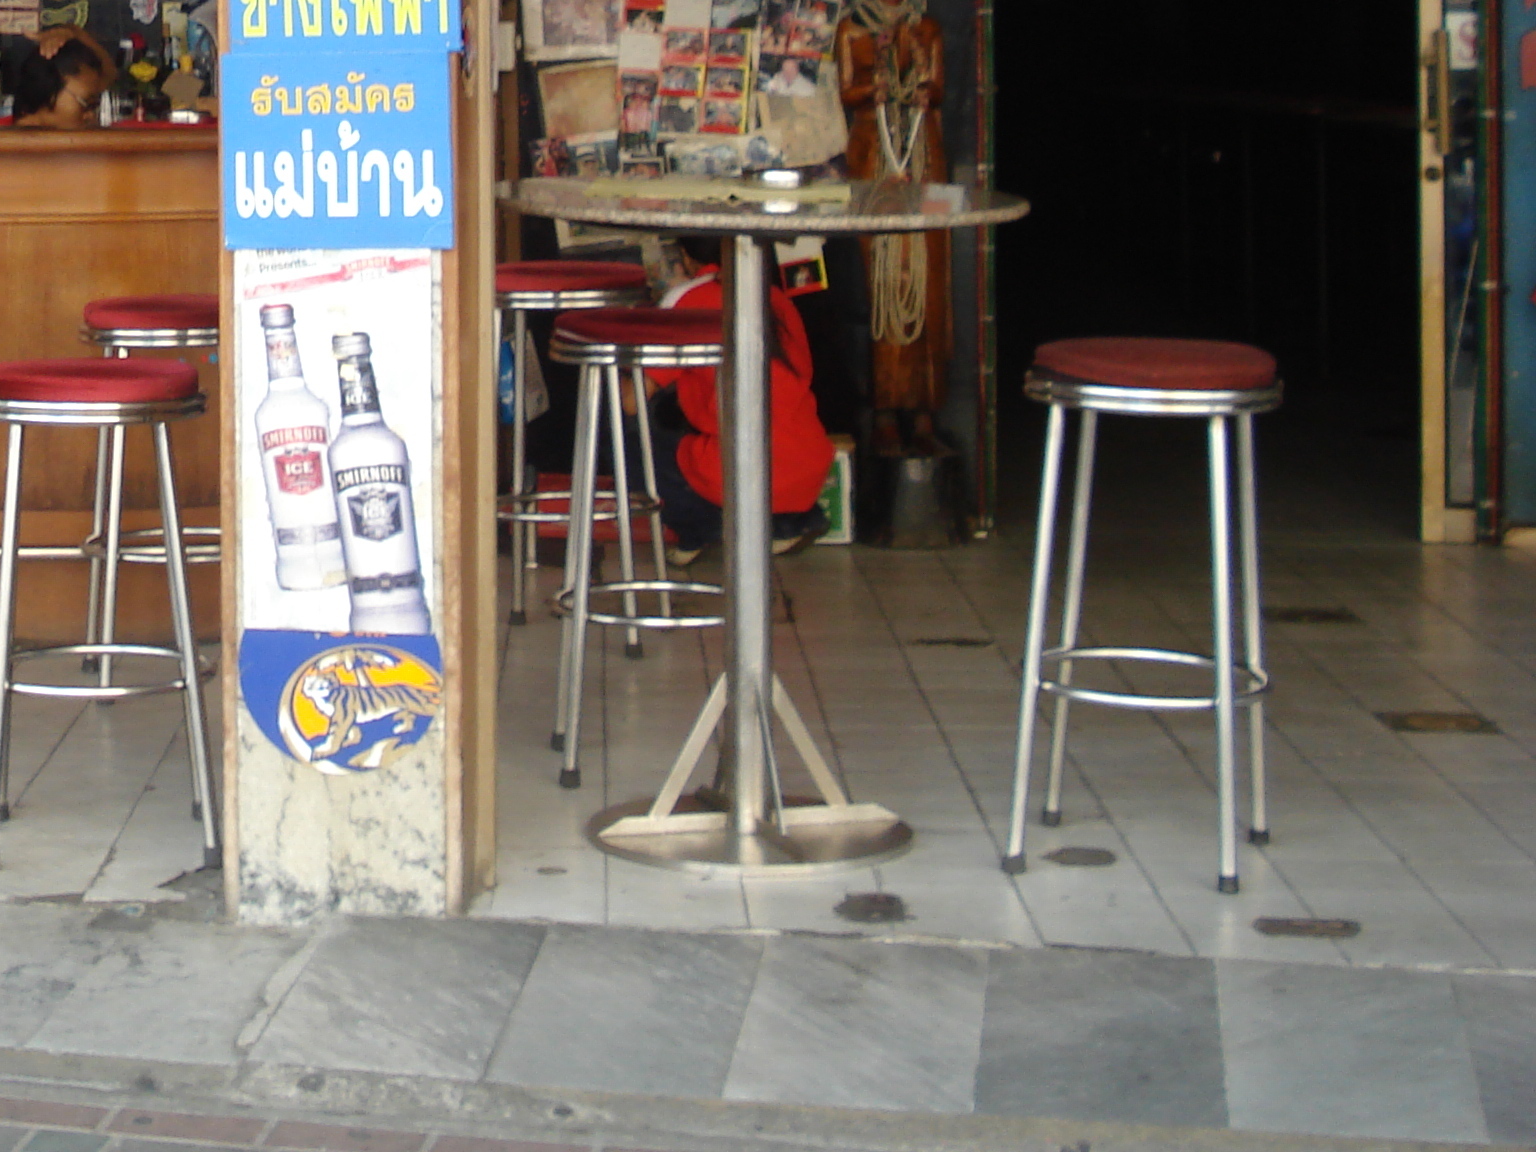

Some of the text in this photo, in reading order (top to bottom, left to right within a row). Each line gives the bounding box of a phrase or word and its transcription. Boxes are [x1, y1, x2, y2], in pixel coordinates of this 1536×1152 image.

[251, 71, 415, 115] รับสมัคร
[235, 119, 444, 218] แม่บ้าน
[263, 426, 326, 450] SMIRNOFF
[284, 461, 314, 476] ICE
[336, 466, 404, 490] SMIRNOFF
